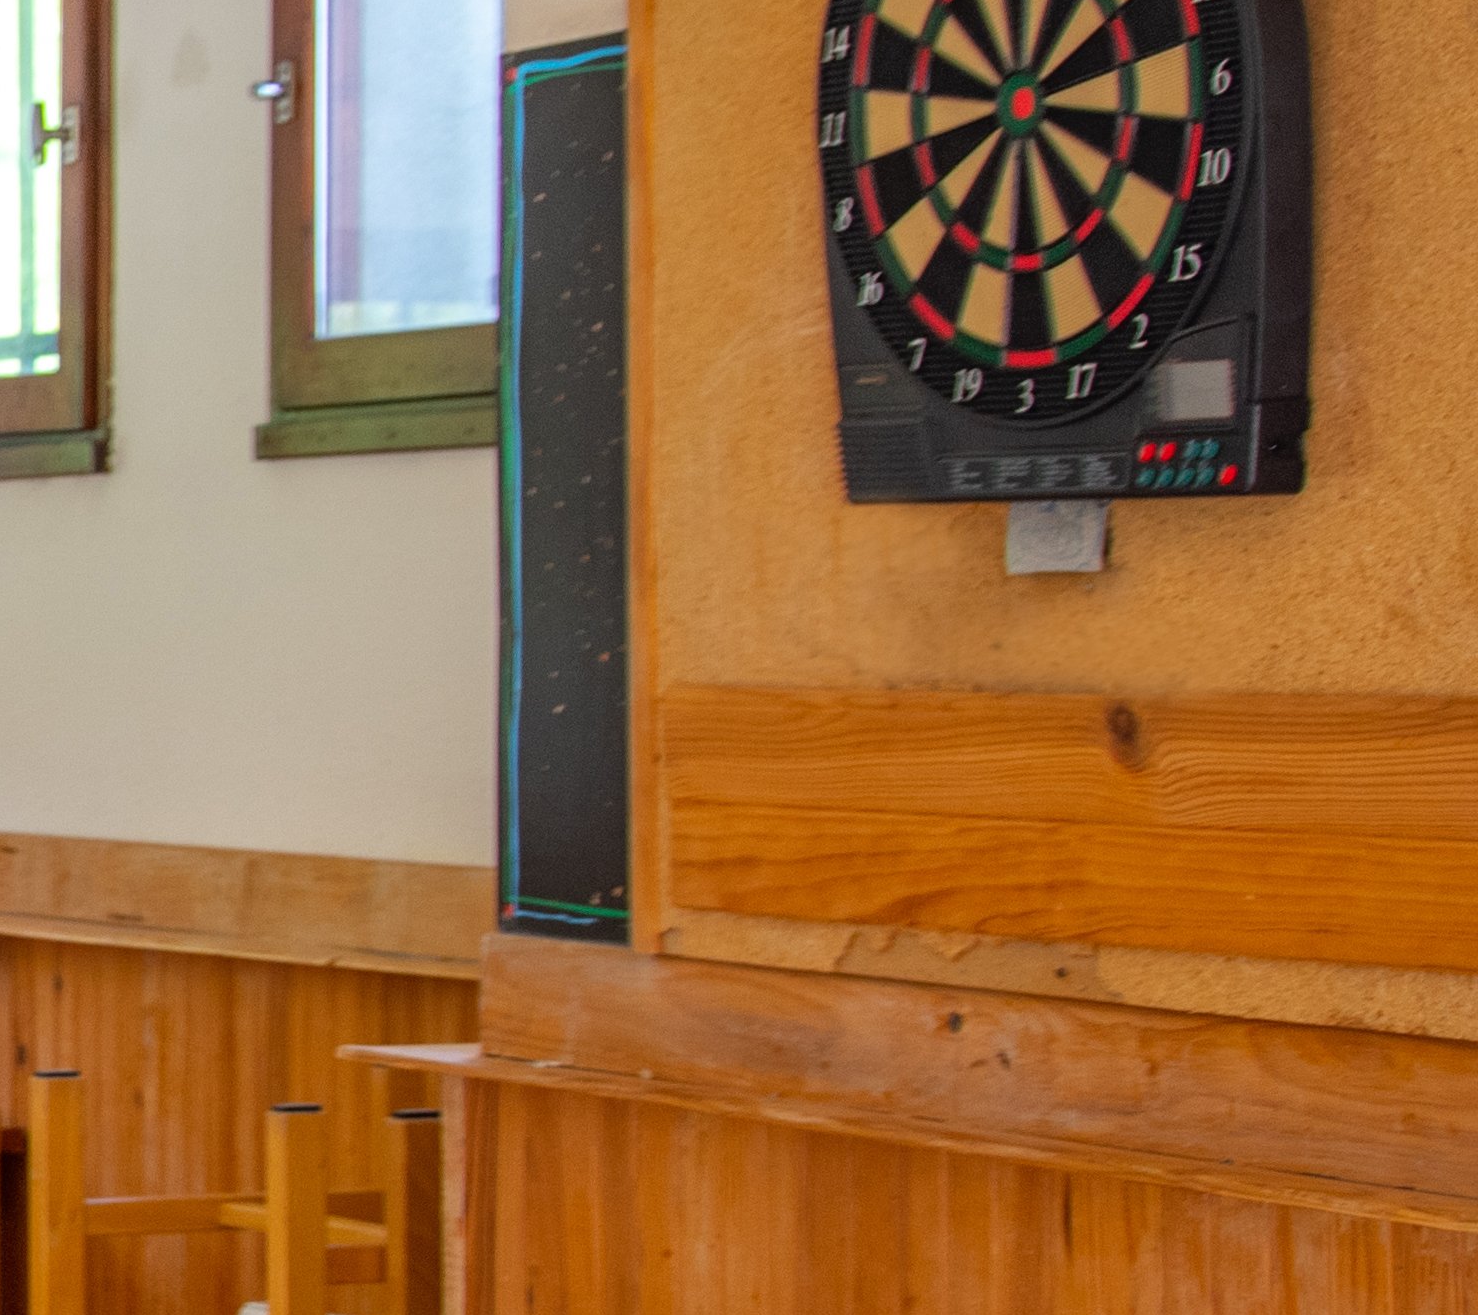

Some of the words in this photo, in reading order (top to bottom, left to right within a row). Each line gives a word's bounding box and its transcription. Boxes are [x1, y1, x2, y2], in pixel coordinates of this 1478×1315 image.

[823, 26, 850, 62] 14
[1212, 58, 1231, 95] 6
[819, 111, 846, 148] 11
[1197, 147, 1231, 187] 10
[835, 197, 853, 232] 8
[1169, 243, 1202, 282] 15
[856, 271, 883, 307] 16
[1130, 313, 1148, 349] 2
[909, 337, 926, 370] 7
[952, 368, 982, 402] 19
[1015, 379, 1034, 414] 3
[1066, 362, 1097, 399] 17
